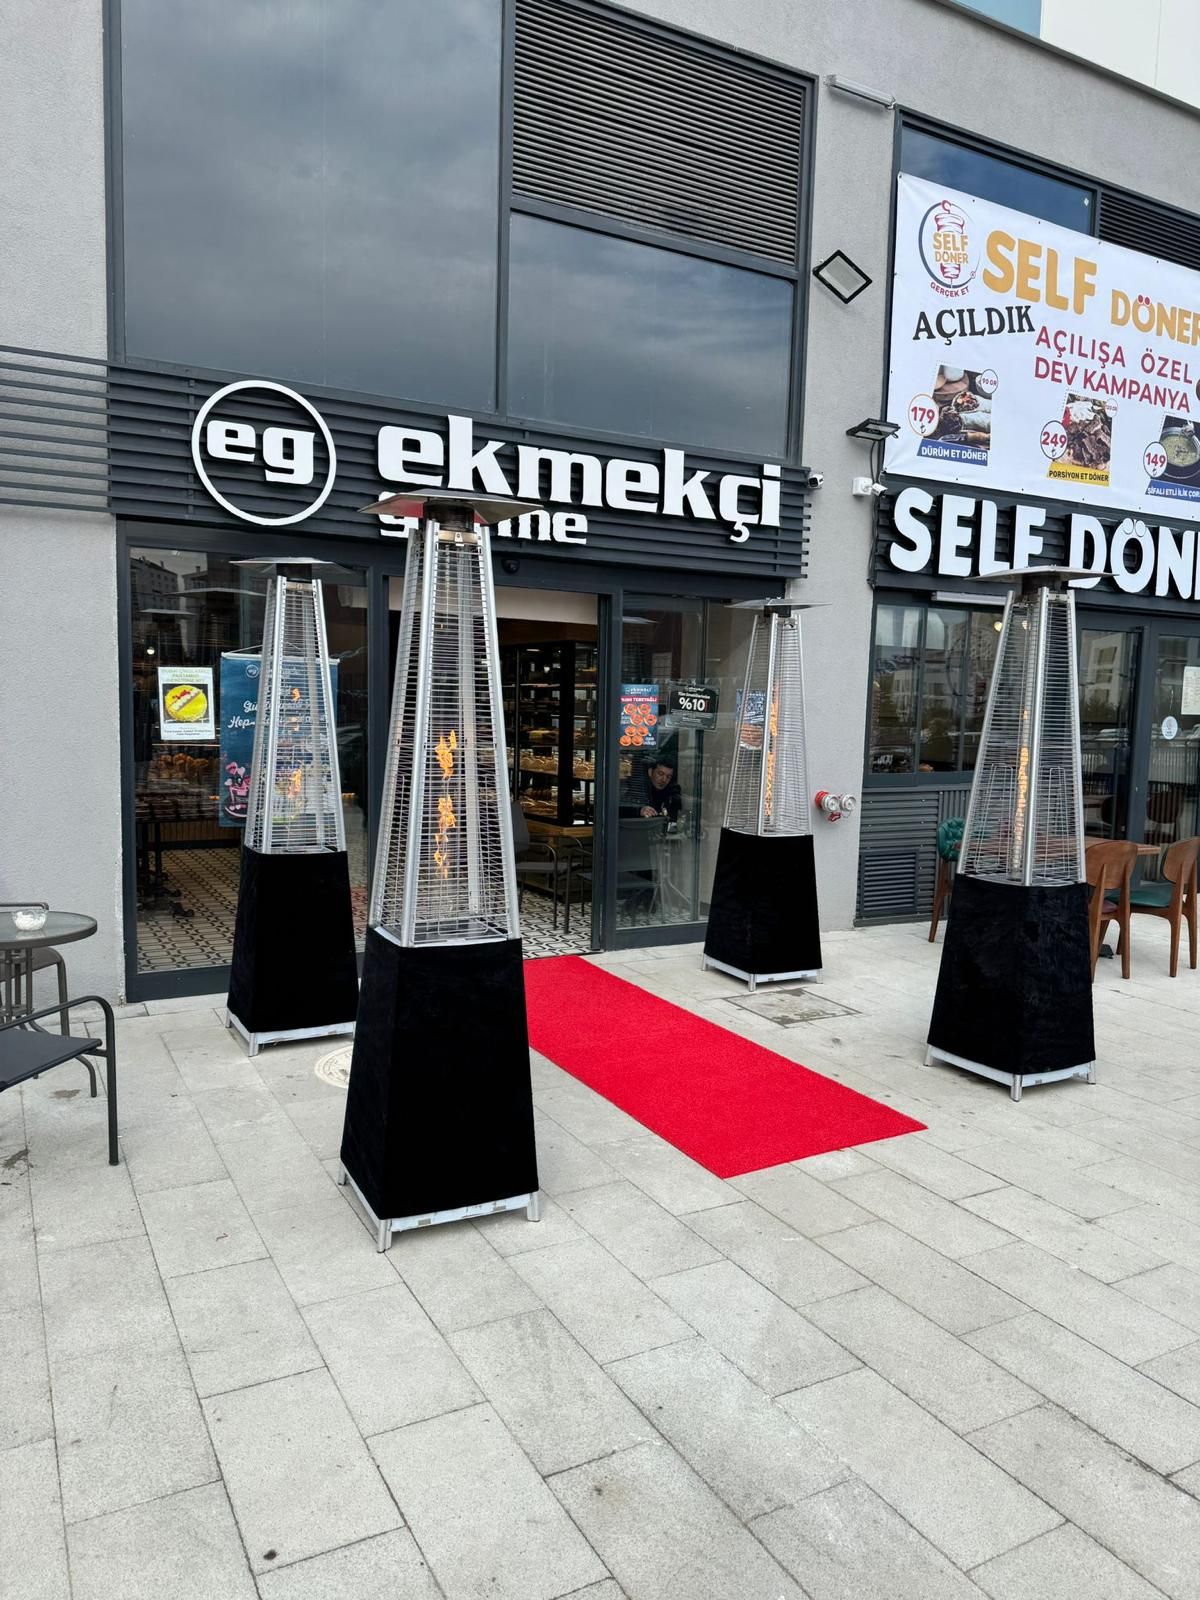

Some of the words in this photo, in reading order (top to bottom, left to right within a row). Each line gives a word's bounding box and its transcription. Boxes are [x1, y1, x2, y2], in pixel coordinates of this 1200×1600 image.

[933, 233, 968, 251] SELF
[935, 251, 969, 264] DÖNER
[930, 282, 960, 298] GERÇEK
[961, 286, 969, 295] ET
[982, 230, 1098, 316] SELF
[1110, 289, 1200, 346] DÖNER
[912, 305, 1036, 346] AÇILDIK
[1035, 325, 1126, 369] AÇILIŞA
[1141, 347, 1193, 384] ÖZEL
[1034, 356, 1078, 387] DEV
[1083, 368, 1190, 413] KAMPANYA
[911, 406, 935, 424] 179
[1041, 432, 1067, 448] 249
[207, 420, 315, 485] eg
[921, 445, 949, 458] DÜRÜM
[951, 450, 960, 458] ET
[962, 450, 988, 461] DÖNER
[1145, 452, 1166, 468] 149
[377, 414, 781, 543] ekmekçi
[1049, 469, 1080, 480] PORSİYON
[1089, 472, 1109, 482] DÖNER
[889, 487, 1046, 578] SELF
[1067, 513, 1200, 600] DÖN
[679, 696, 706, 711] %10
